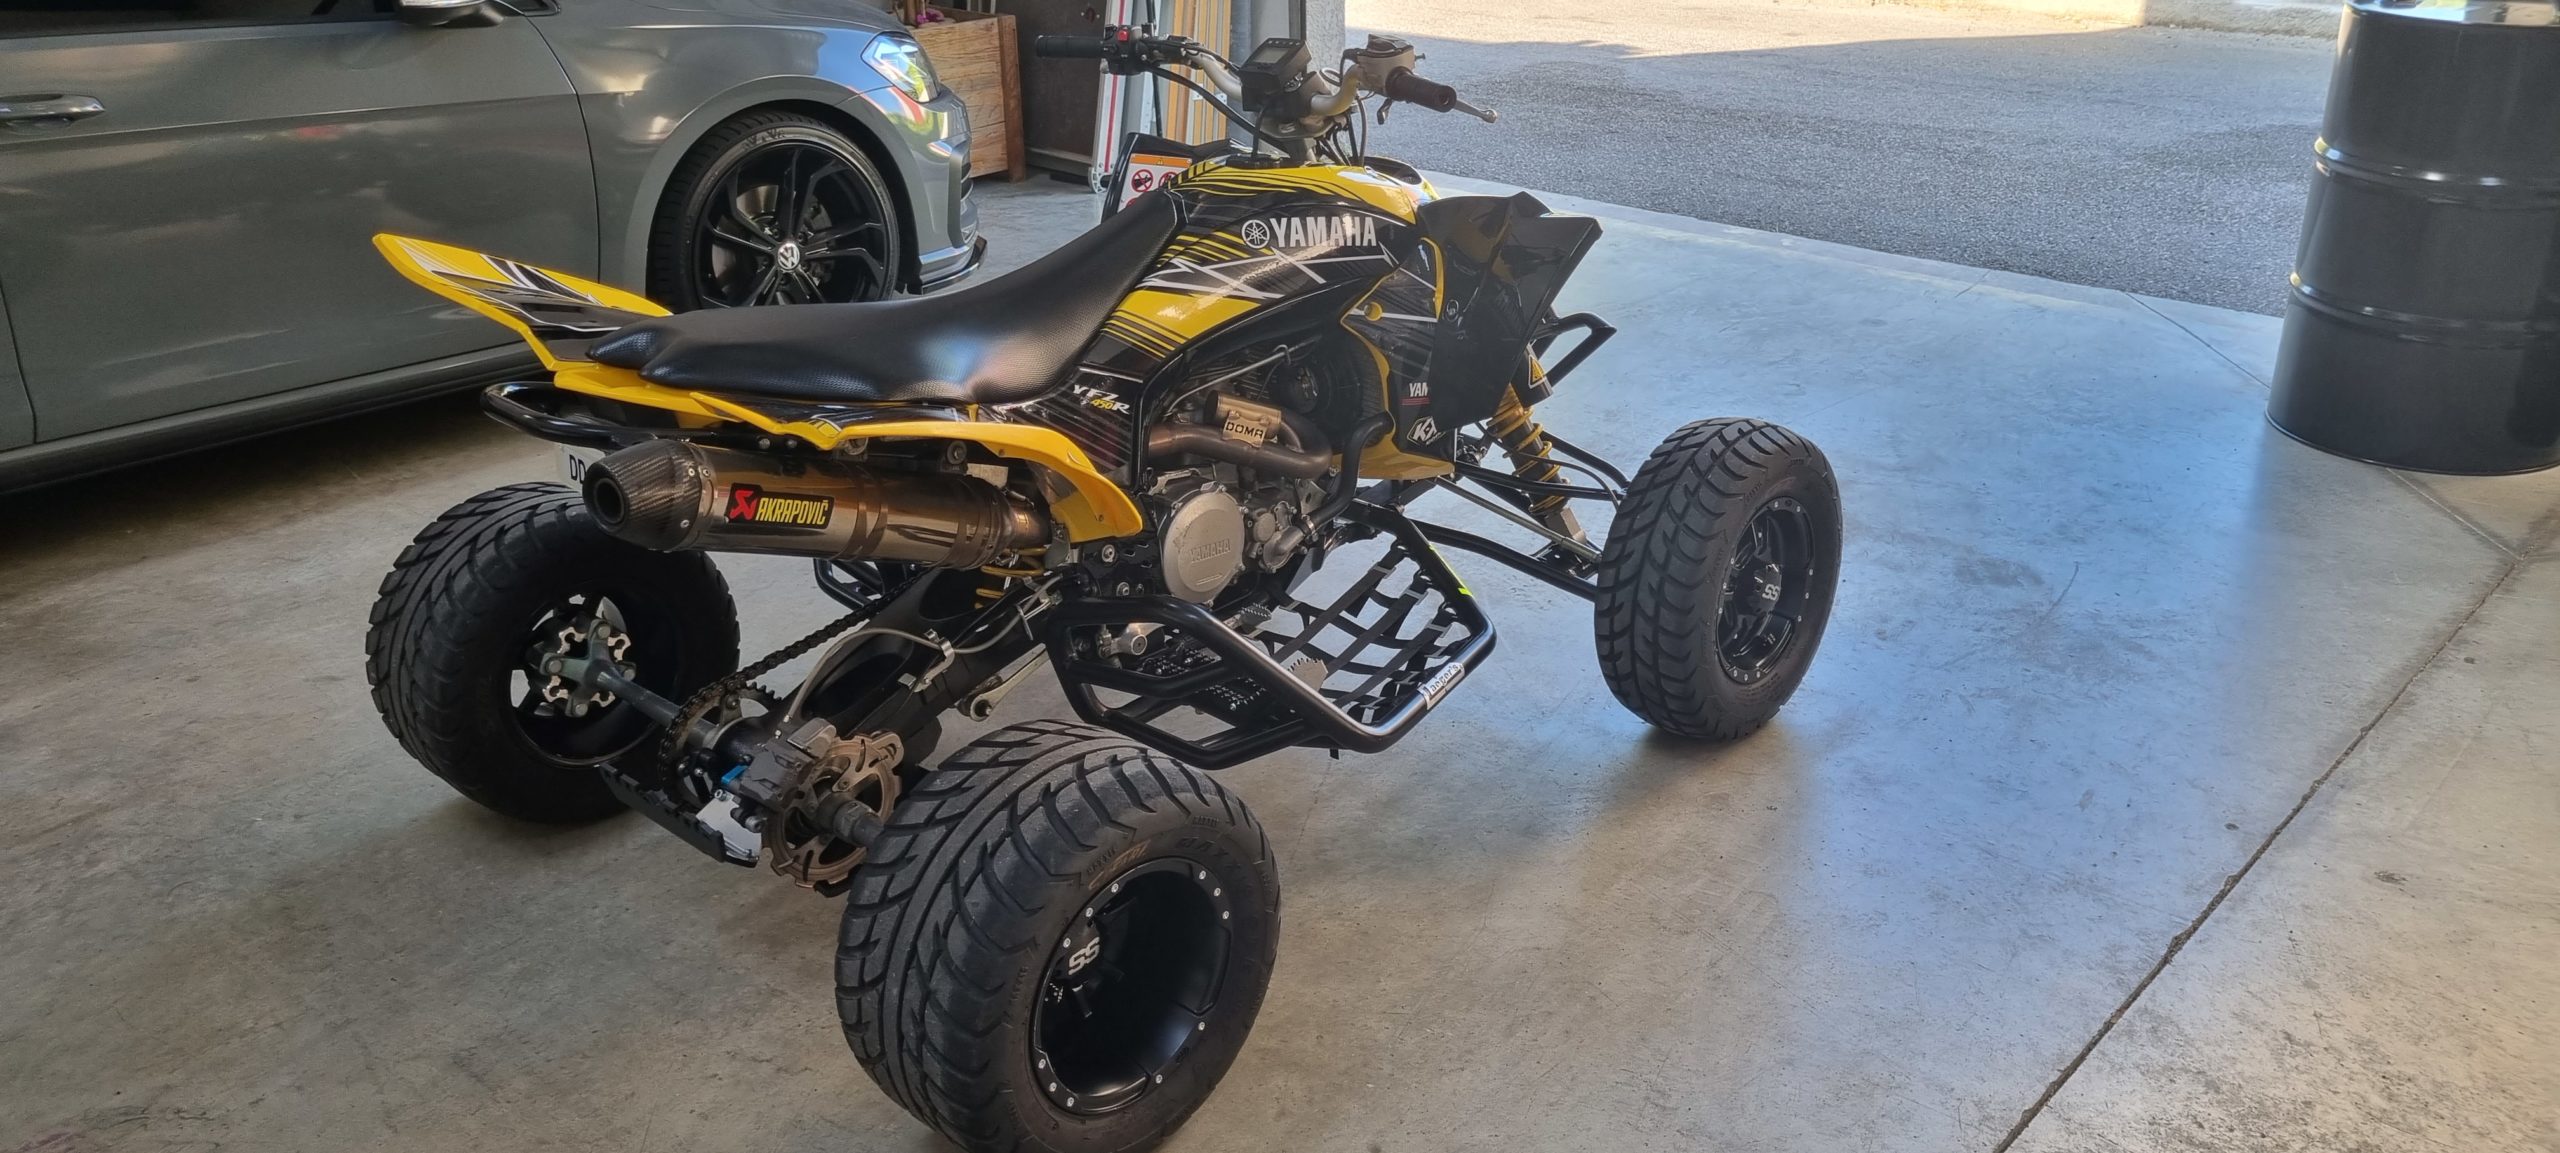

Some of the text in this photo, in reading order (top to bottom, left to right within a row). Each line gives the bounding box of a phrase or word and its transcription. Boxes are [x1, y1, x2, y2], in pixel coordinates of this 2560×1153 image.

[1269, 216, 1377, 248] YAMAHA
[1073, 384, 1119, 402] YFZ
[1226, 421, 1264, 439] DOMA
[569, 454, 587, 485] DD
[755, 497, 829, 525] AKRAPOVIČ
[1190, 538, 1231, 563] YAMAHA
[1762, 583, 1780, 601] SS
[1068, 936, 1100, 976] SS
